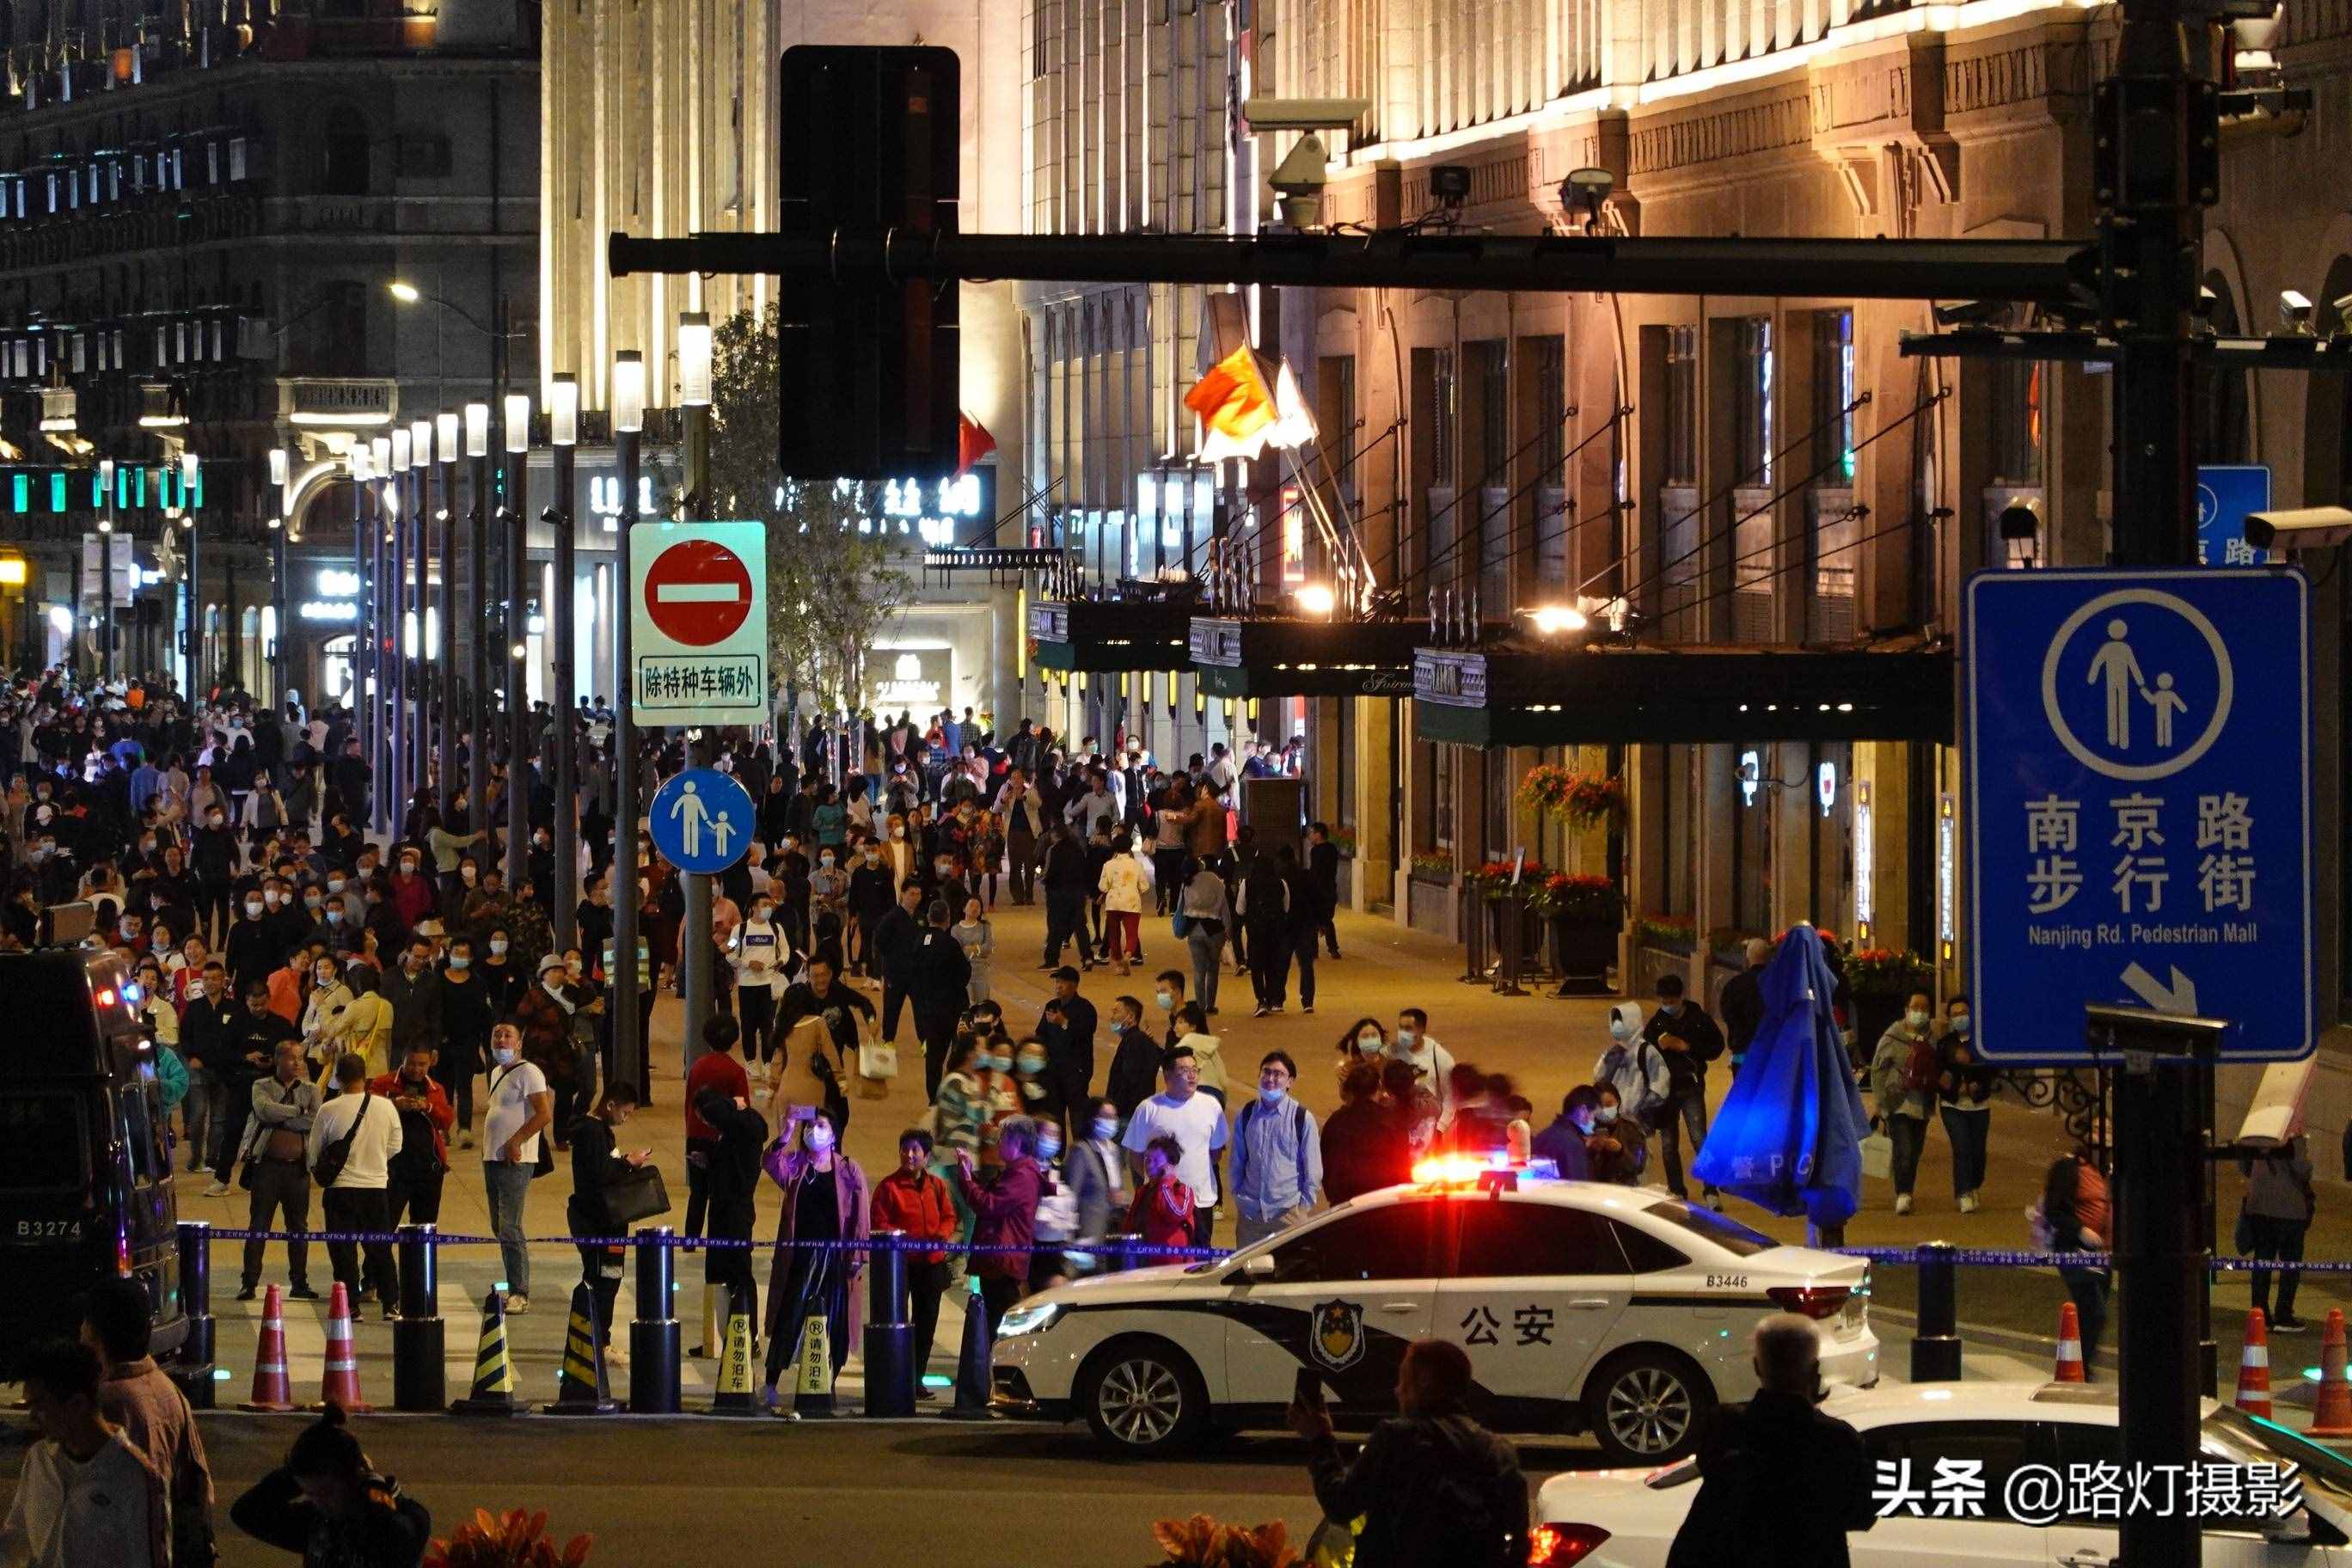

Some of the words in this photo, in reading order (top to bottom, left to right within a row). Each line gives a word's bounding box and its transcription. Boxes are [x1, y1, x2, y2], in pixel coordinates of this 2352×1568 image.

[646, 665, 753, 698] 除特种车辆外
[2024, 791, 2254, 854] 南京路
[2026, 854, 2256, 914] 步行街
[2029, 925, 2092, 949] Nanjing
[2097, 924, 2124, 944] Rd.
[2131, 922, 2218, 943] Pedestrian
[2224, 922, 2257, 942] Mall
[16, 1219, 82, 1236] B3274
[1707, 1275, 1748, 1288] B3446
[1461, 1304, 1554, 1346] 公安
